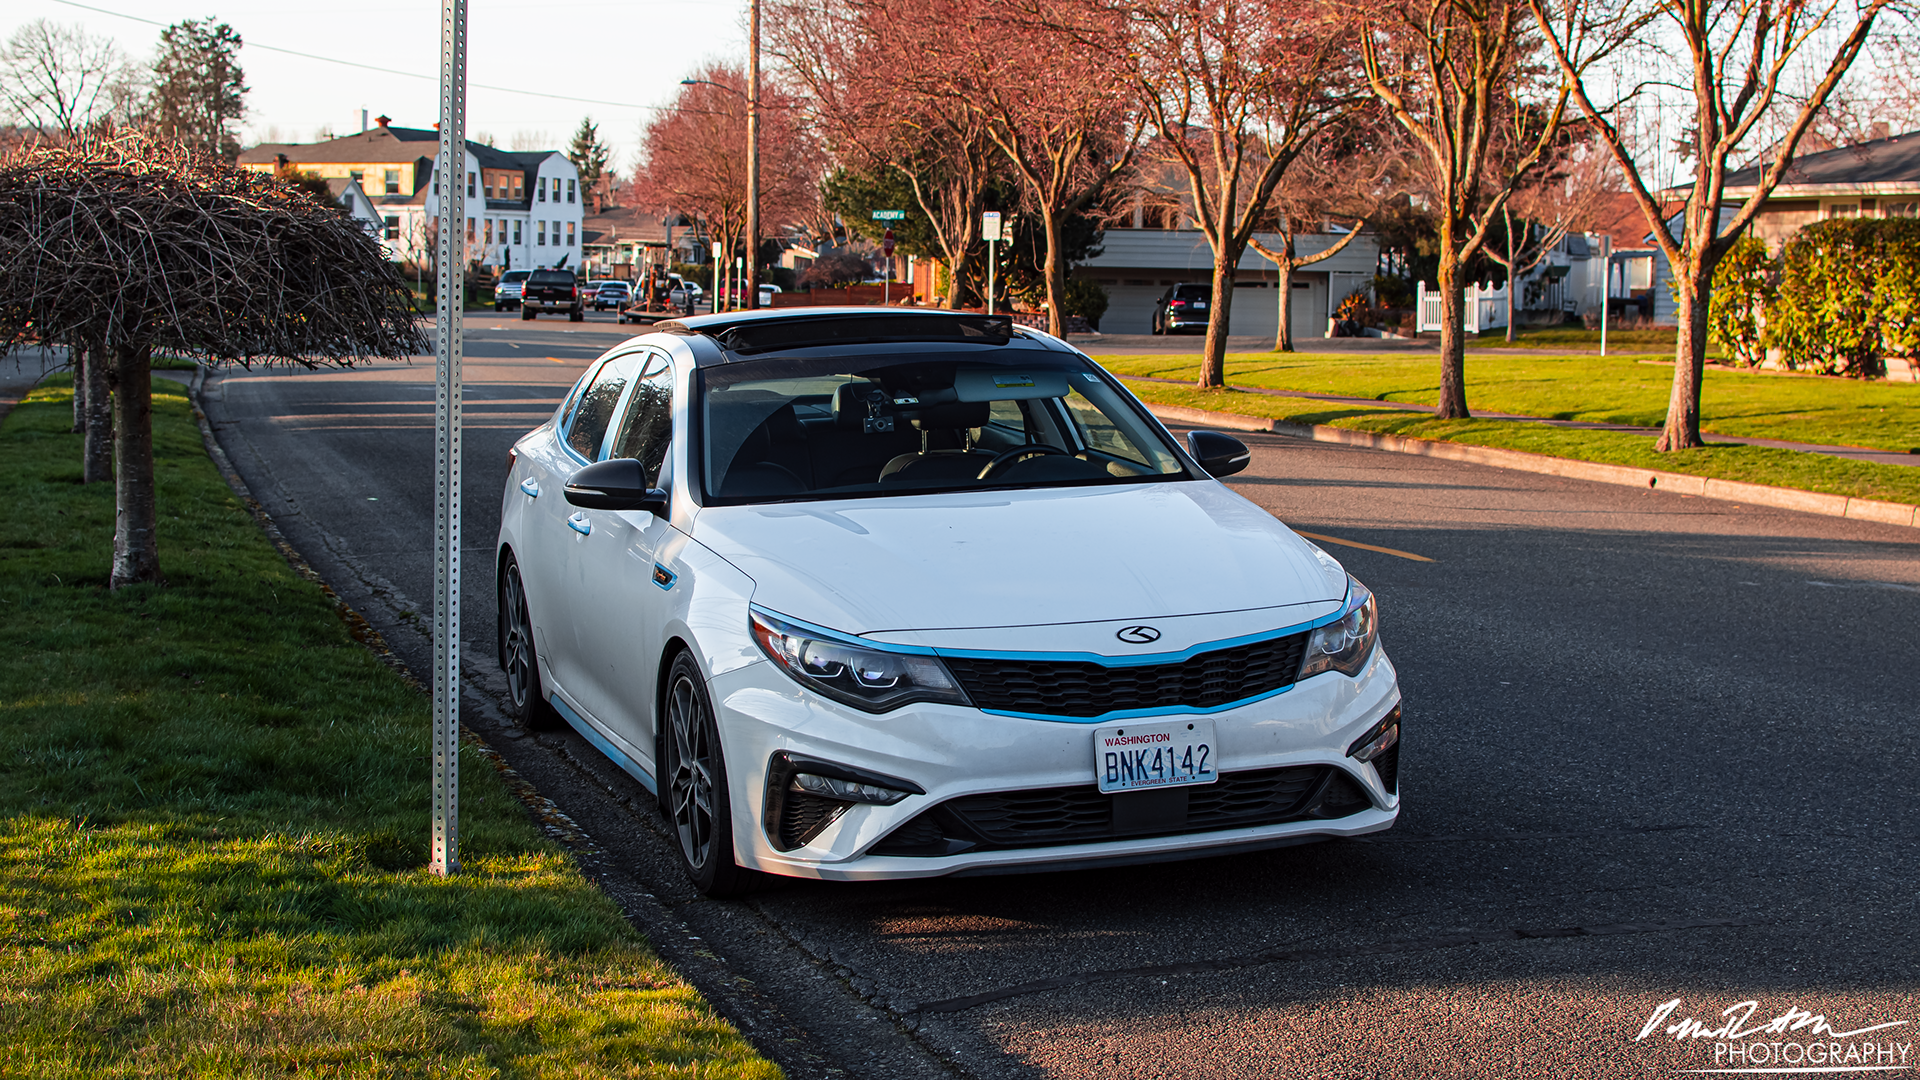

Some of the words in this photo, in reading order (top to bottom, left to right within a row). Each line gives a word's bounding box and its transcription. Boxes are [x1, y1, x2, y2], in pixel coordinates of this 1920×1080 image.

[1105, 733, 1170, 747] WASHINGTON
[1105, 744, 1210, 783] BNK4142
[1131, 778, 1166, 787] EVERGREEN
